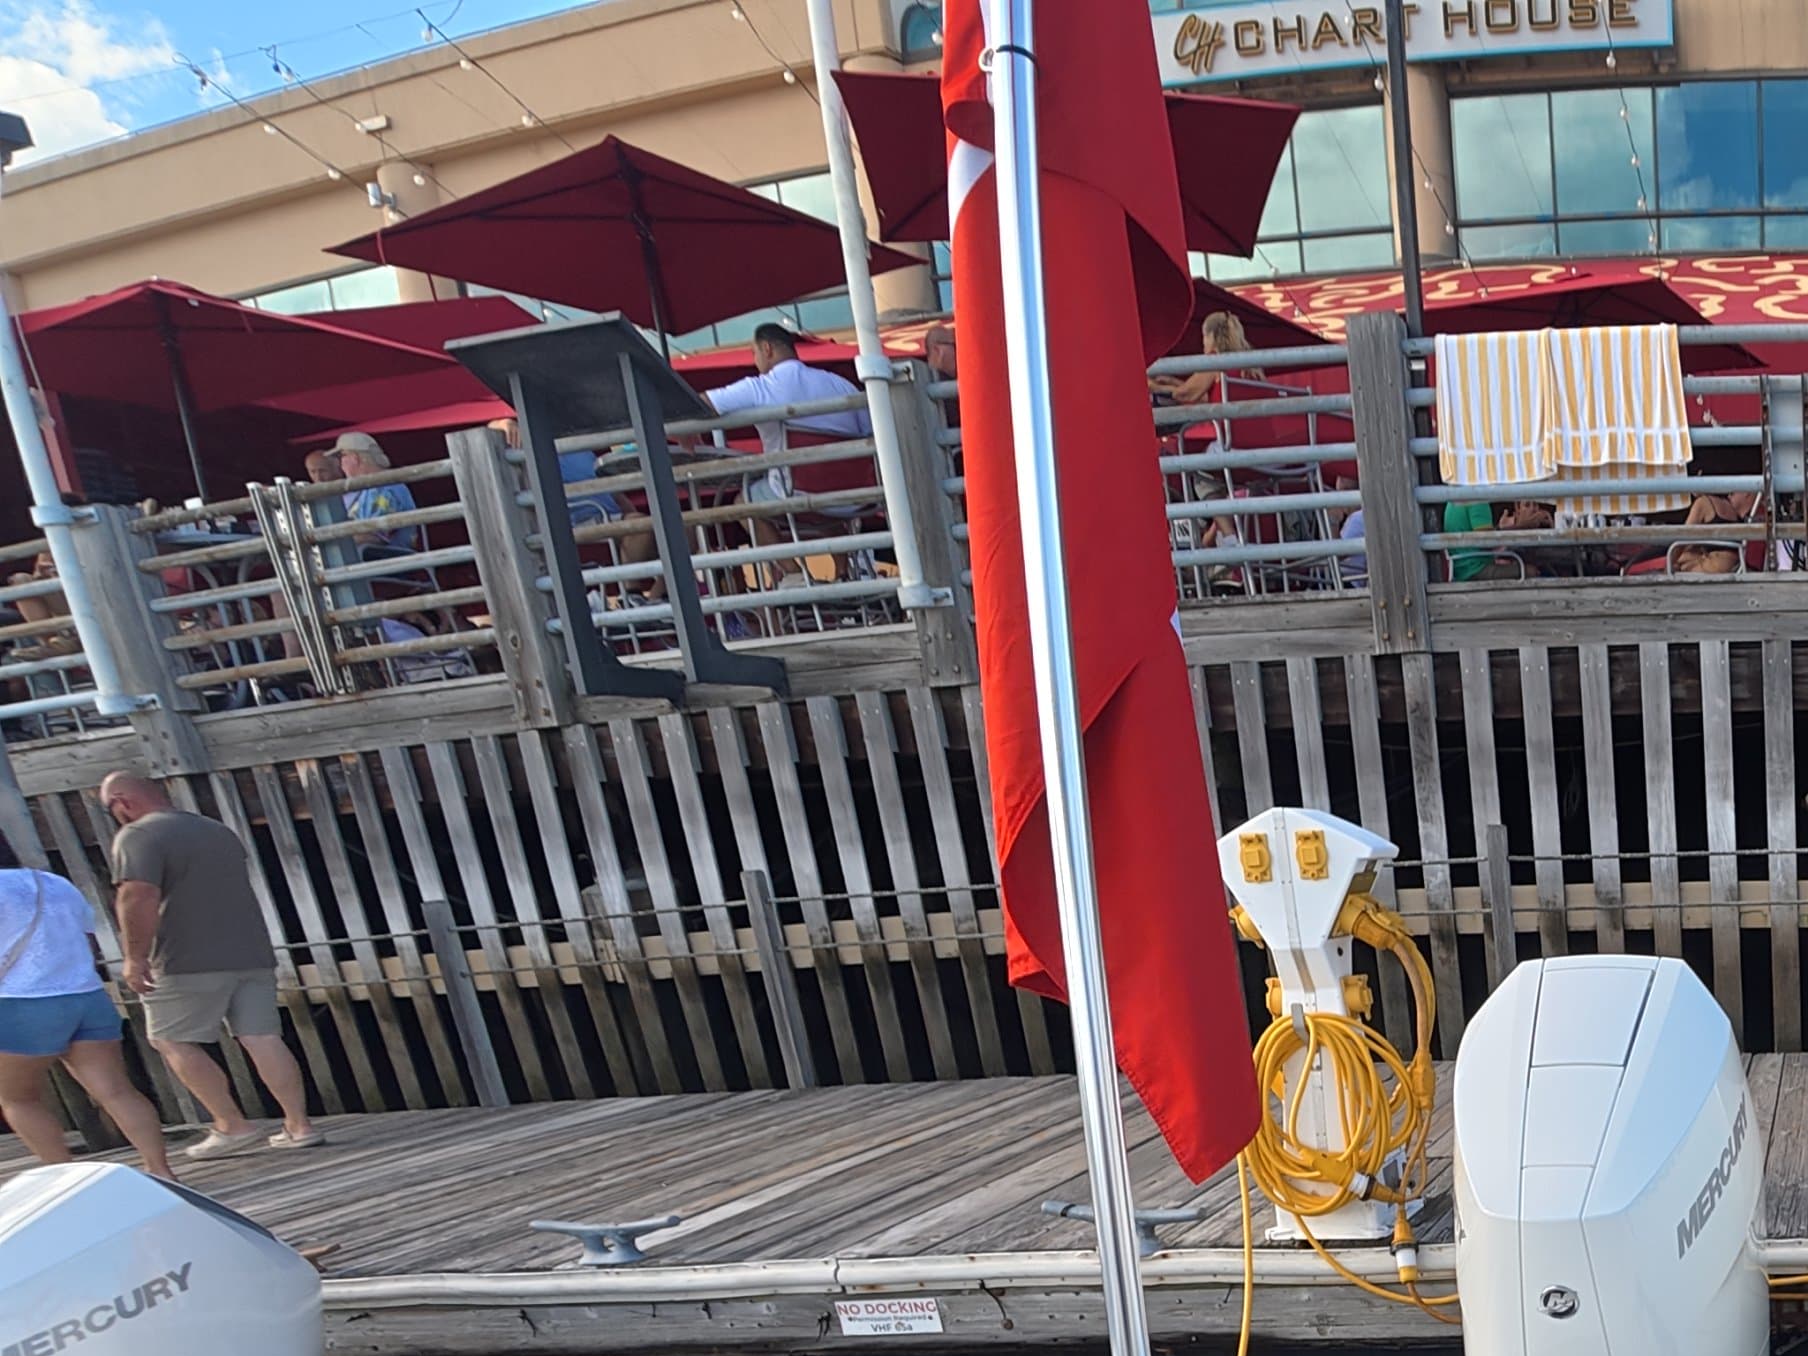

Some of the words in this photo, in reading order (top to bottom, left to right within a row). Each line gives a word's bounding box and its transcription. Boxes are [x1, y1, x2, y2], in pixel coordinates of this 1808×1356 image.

[1443, 0, 1639, 38] HOUSE
[1676, 1091, 1748, 1259] MERCURY
[837, 1303, 861, 1315] NO
[864, 1301, 937, 1315] DOCKING
[870, 1323, 892, 1332] VHF
